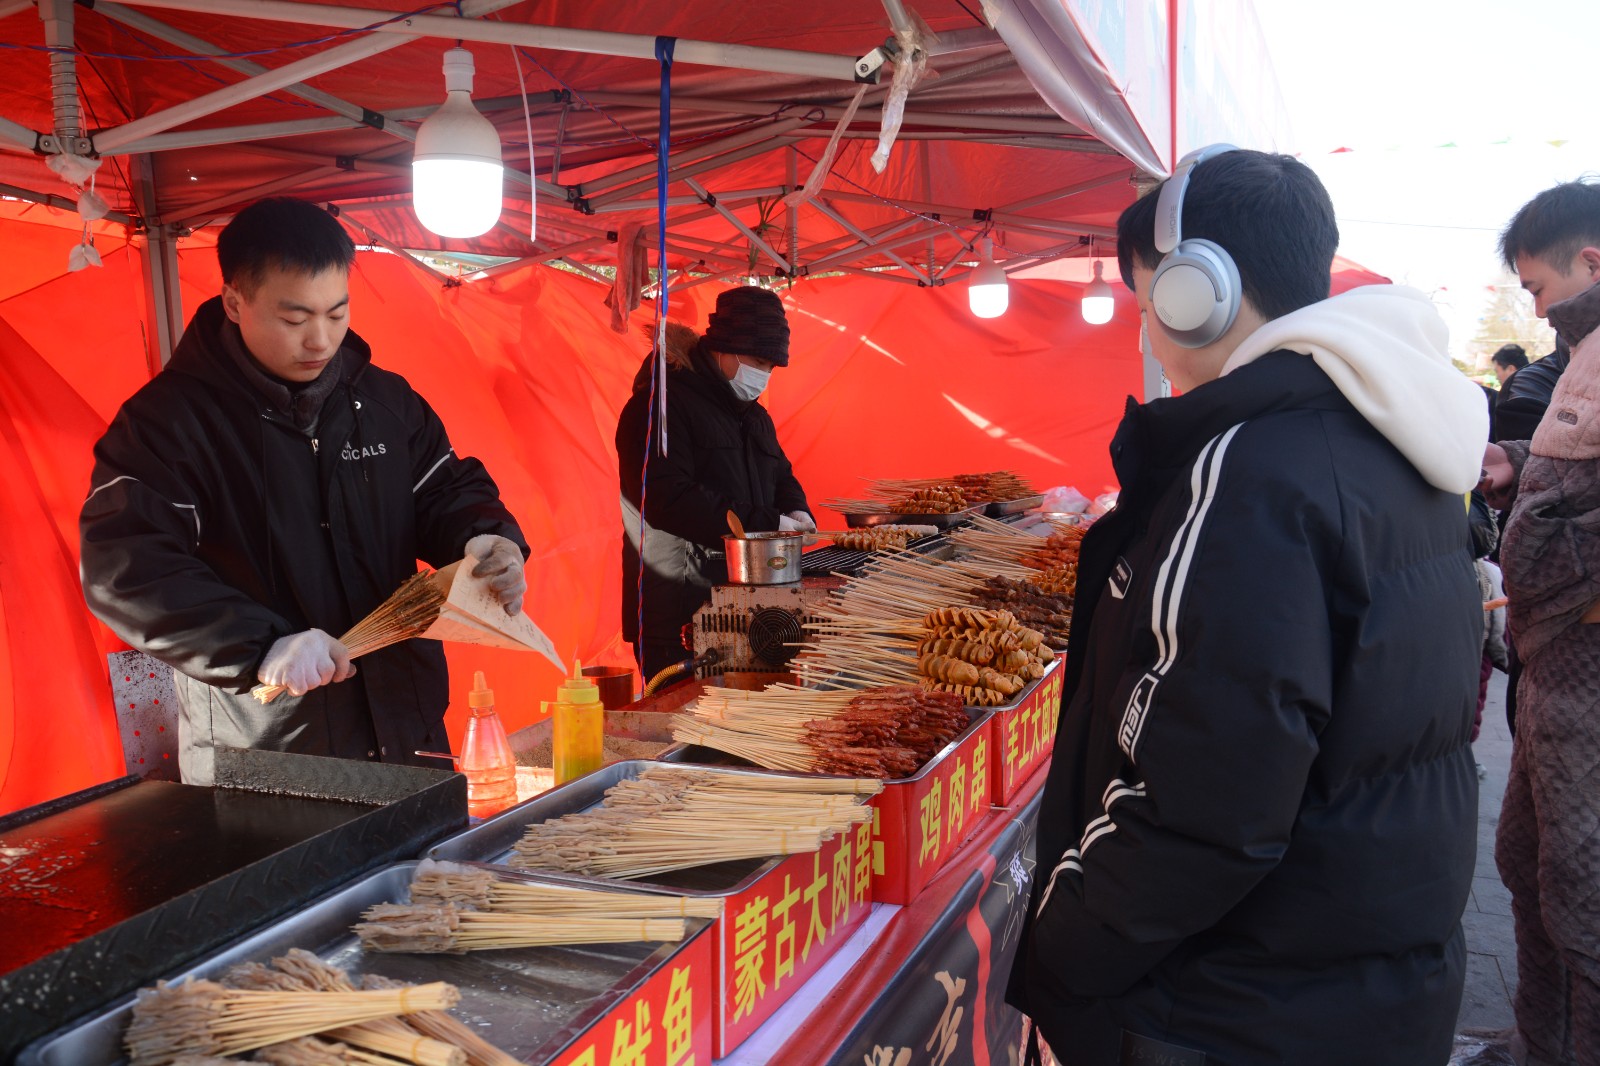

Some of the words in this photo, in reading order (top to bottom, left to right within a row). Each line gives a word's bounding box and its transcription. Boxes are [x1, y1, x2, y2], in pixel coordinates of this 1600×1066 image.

[918, 735, 987, 868] 鸡肉串
[733, 806, 885, 1025] 蒙古大肉串
[567, 964, 696, 1066] 鱿鱼
